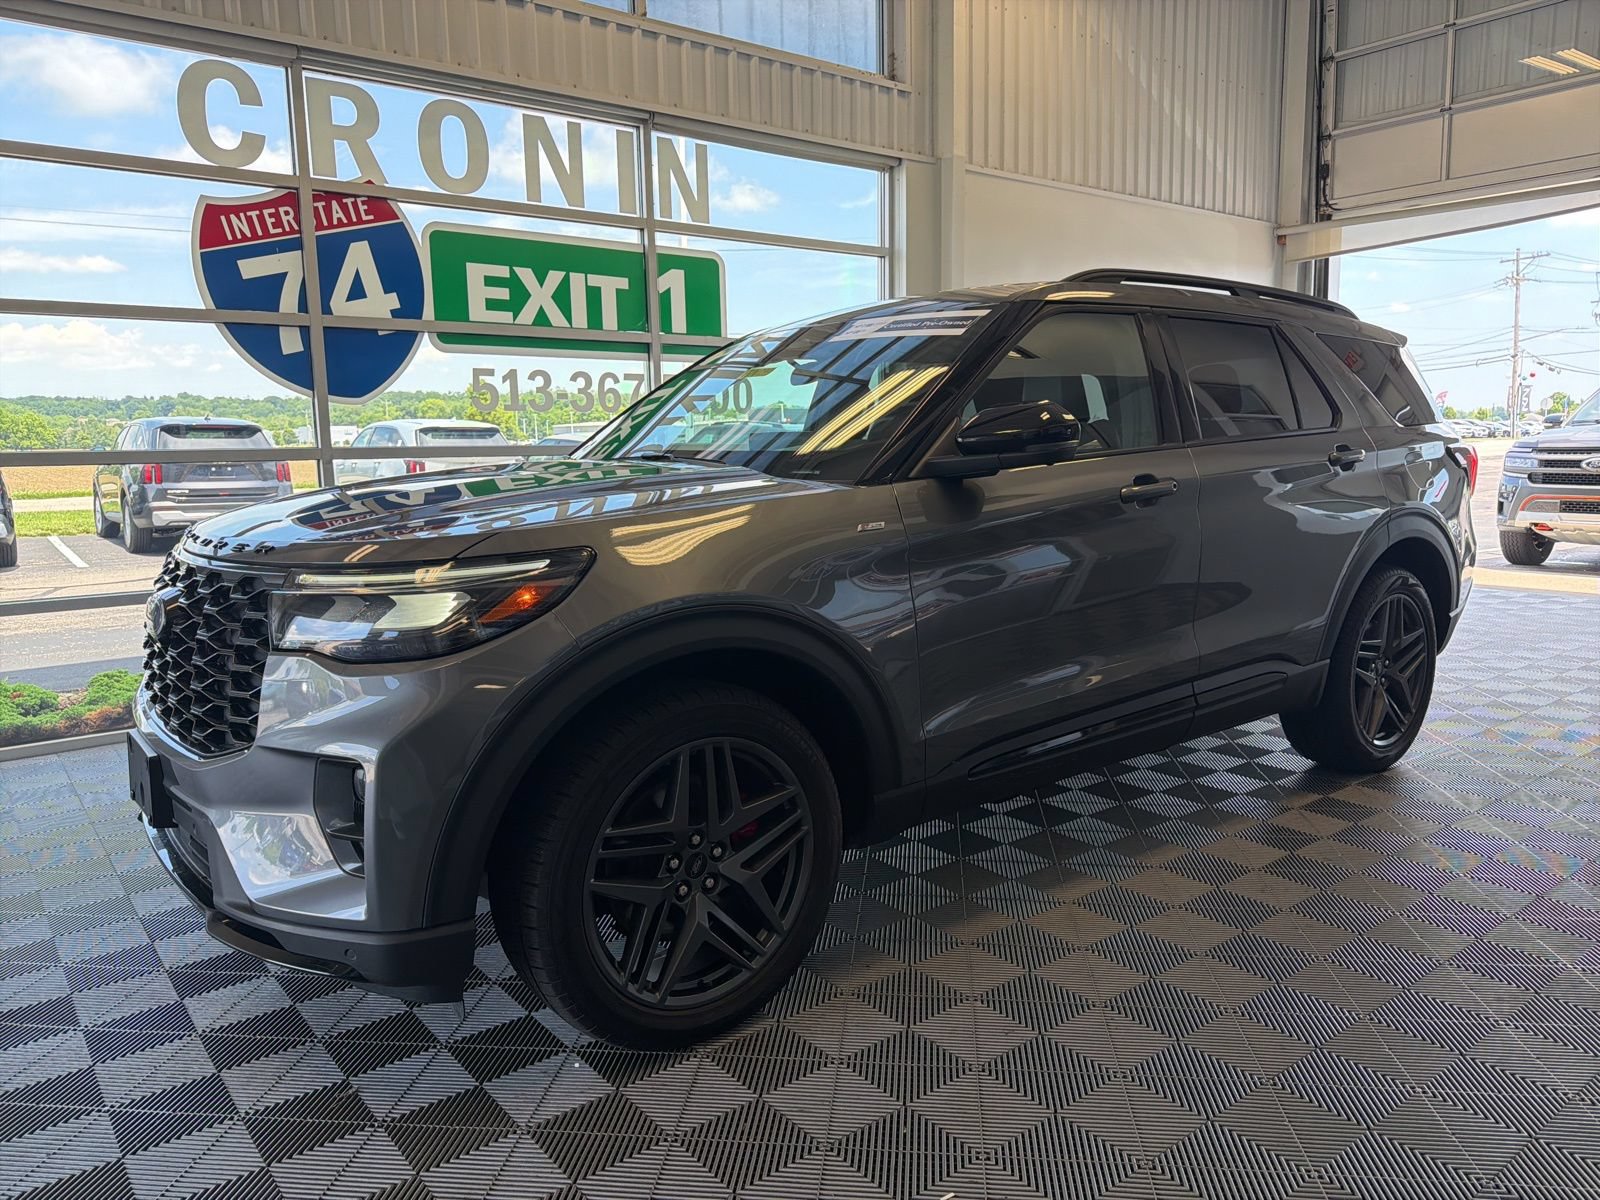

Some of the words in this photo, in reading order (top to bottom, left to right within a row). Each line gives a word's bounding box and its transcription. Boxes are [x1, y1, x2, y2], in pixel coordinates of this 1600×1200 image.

[176, 59, 710, 224] CRONIN
[219, 197, 375, 241] INTERTATE
[236, 240, 401, 355] 74
[465, 261, 630, 331] EXIT
[657, 268, 687, 334] 1
